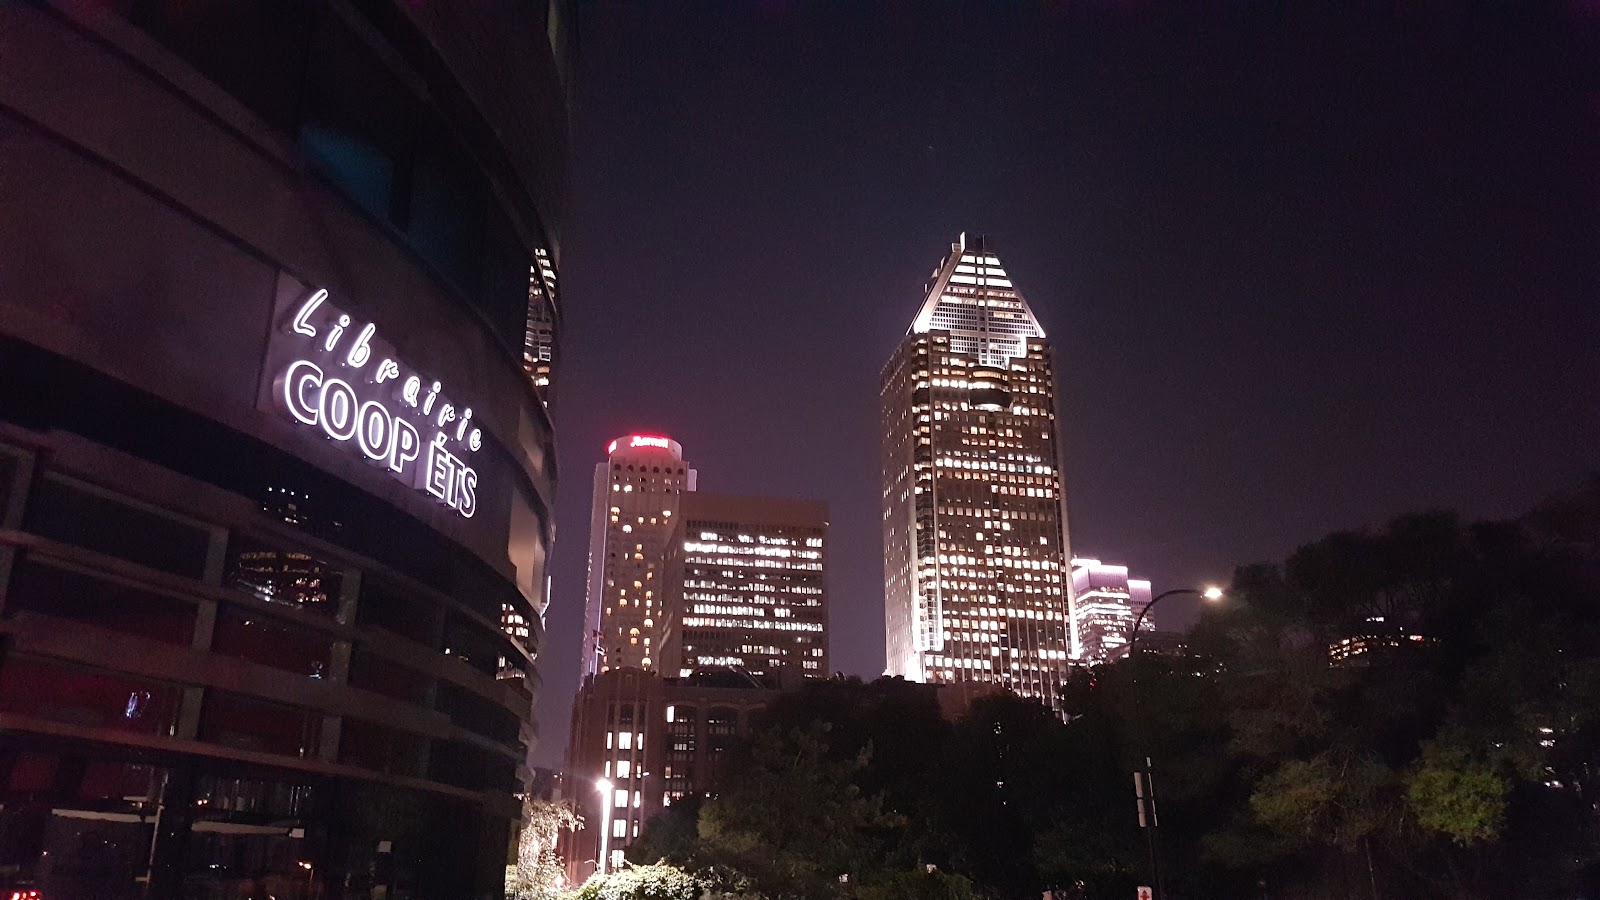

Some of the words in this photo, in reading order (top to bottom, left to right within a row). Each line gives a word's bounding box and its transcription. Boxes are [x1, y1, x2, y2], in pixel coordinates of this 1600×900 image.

[285, 360, 420, 473] COOP
[427, 433, 478, 519] ÉTS
[293, 288, 482, 452] Librairie
